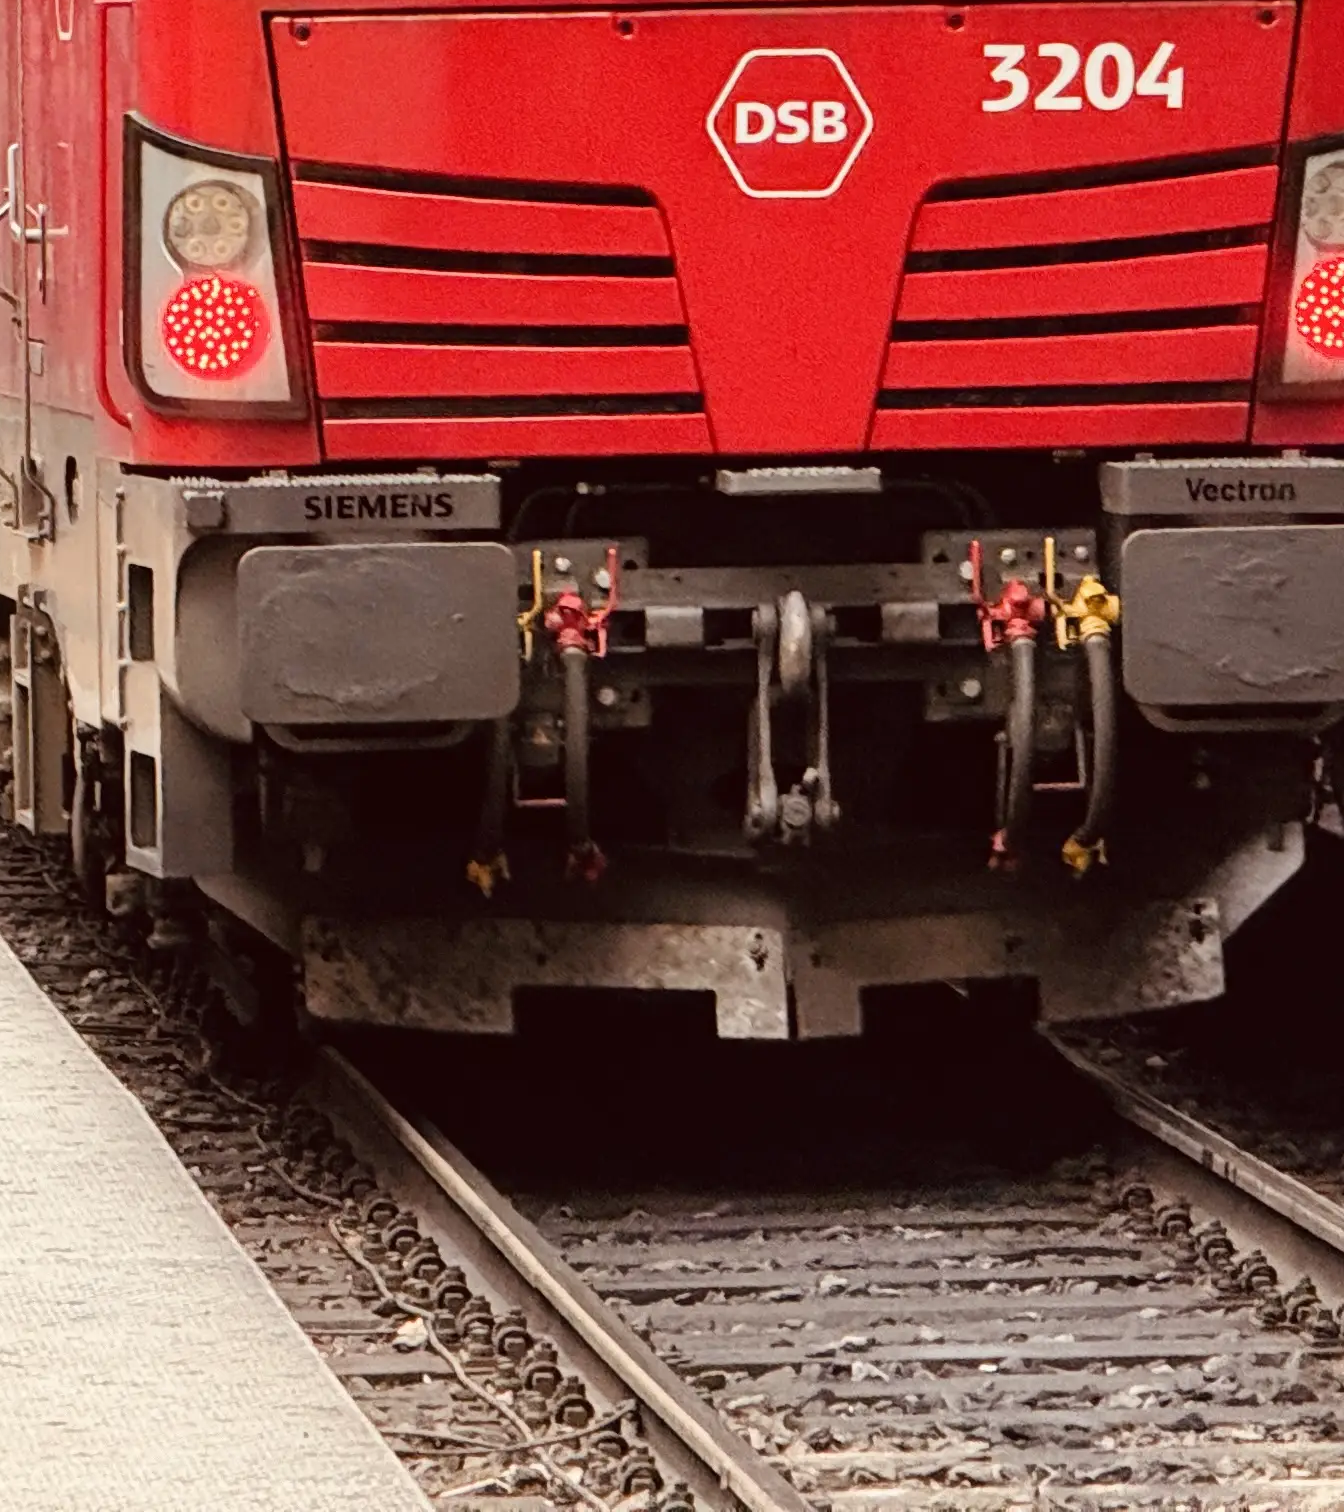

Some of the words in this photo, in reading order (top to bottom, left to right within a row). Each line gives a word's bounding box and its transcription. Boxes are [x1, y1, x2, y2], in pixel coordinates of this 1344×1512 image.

[981, 42, 1184, 111] 3204
[734, 101, 847, 144] DSB
[304, 492, 453, 521] SIEMENS
[1185, 478, 1296, 502] Vectron
